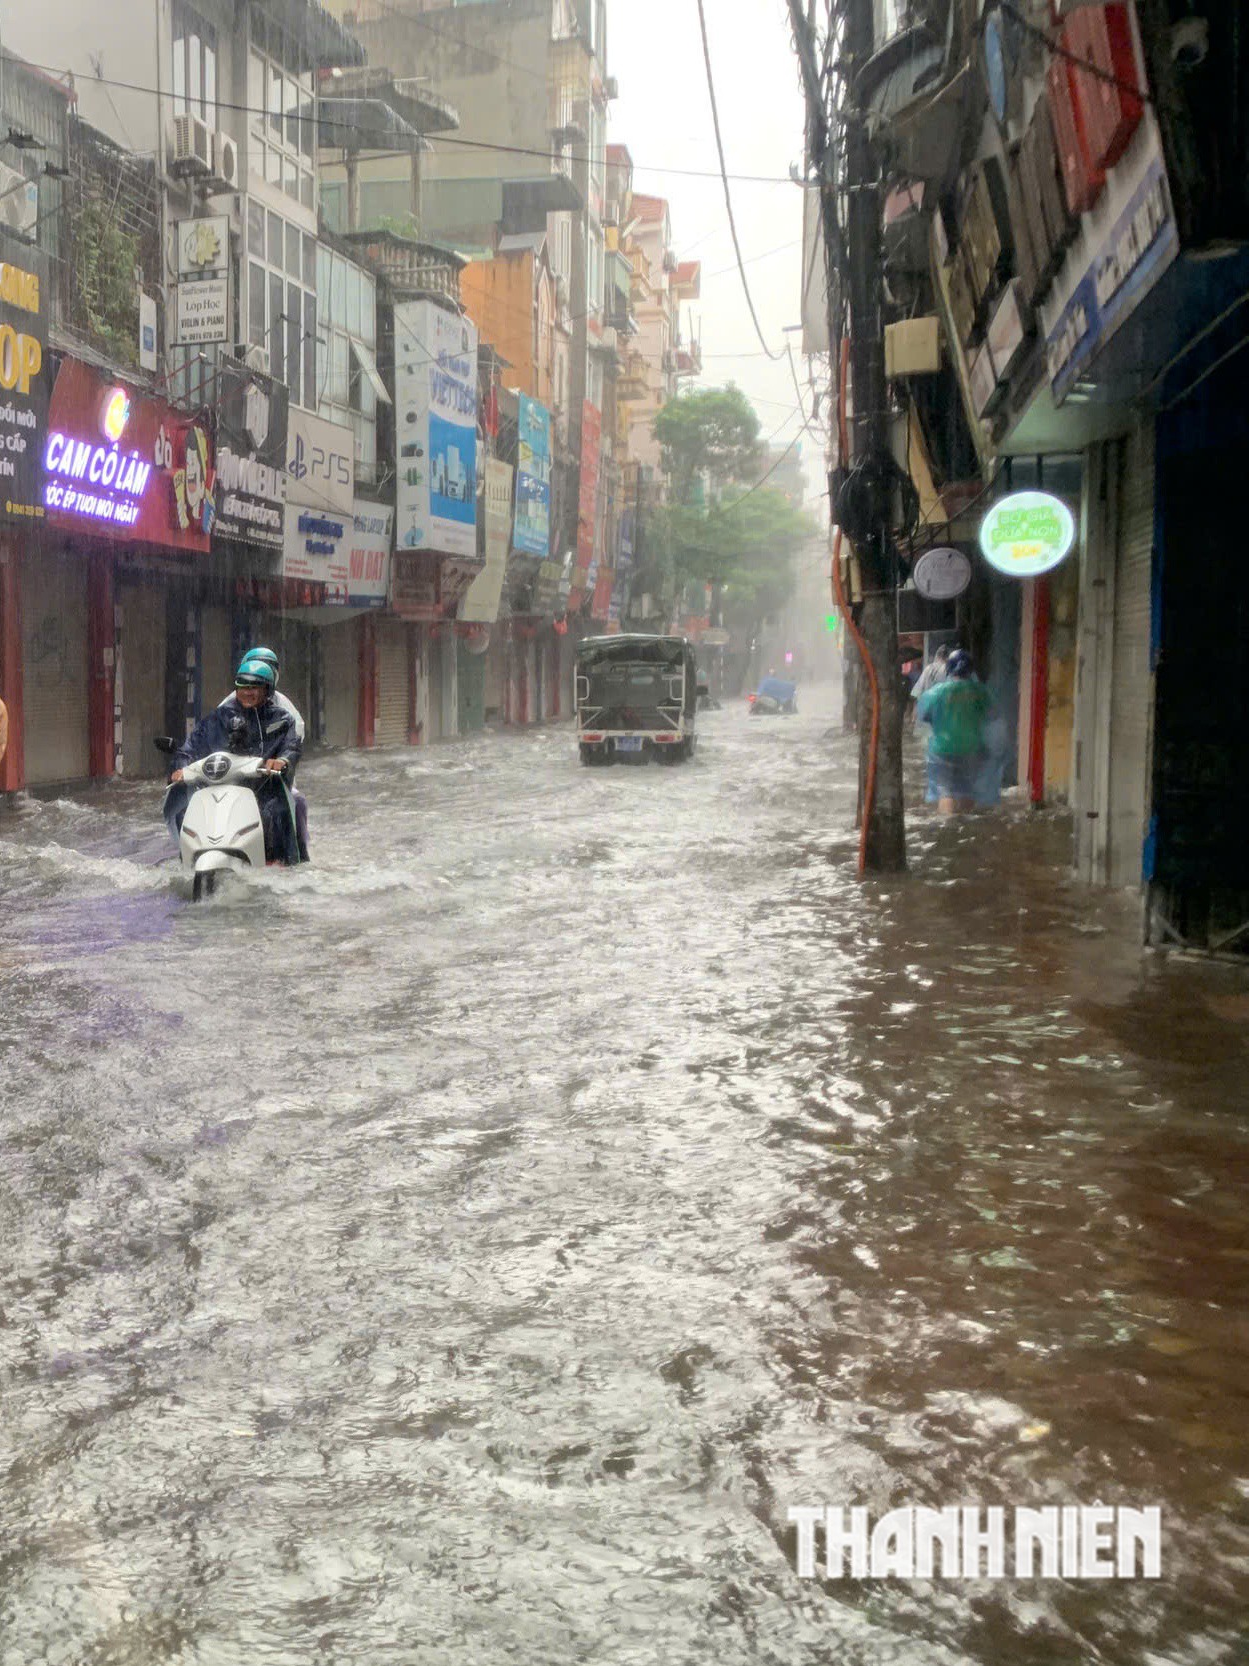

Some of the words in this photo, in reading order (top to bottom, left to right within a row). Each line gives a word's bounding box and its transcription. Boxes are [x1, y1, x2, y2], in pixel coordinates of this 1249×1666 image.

[207, 315, 224, 325] PIANO
[6, 432, 27, 453] CẤP
[46, 432, 92, 480] CAM
[89, 442, 118, 486] CÔ
[114, 450, 151, 496] LÂM
[311, 446, 351, 486] PS5
[62, 484, 76, 509] ÉP
